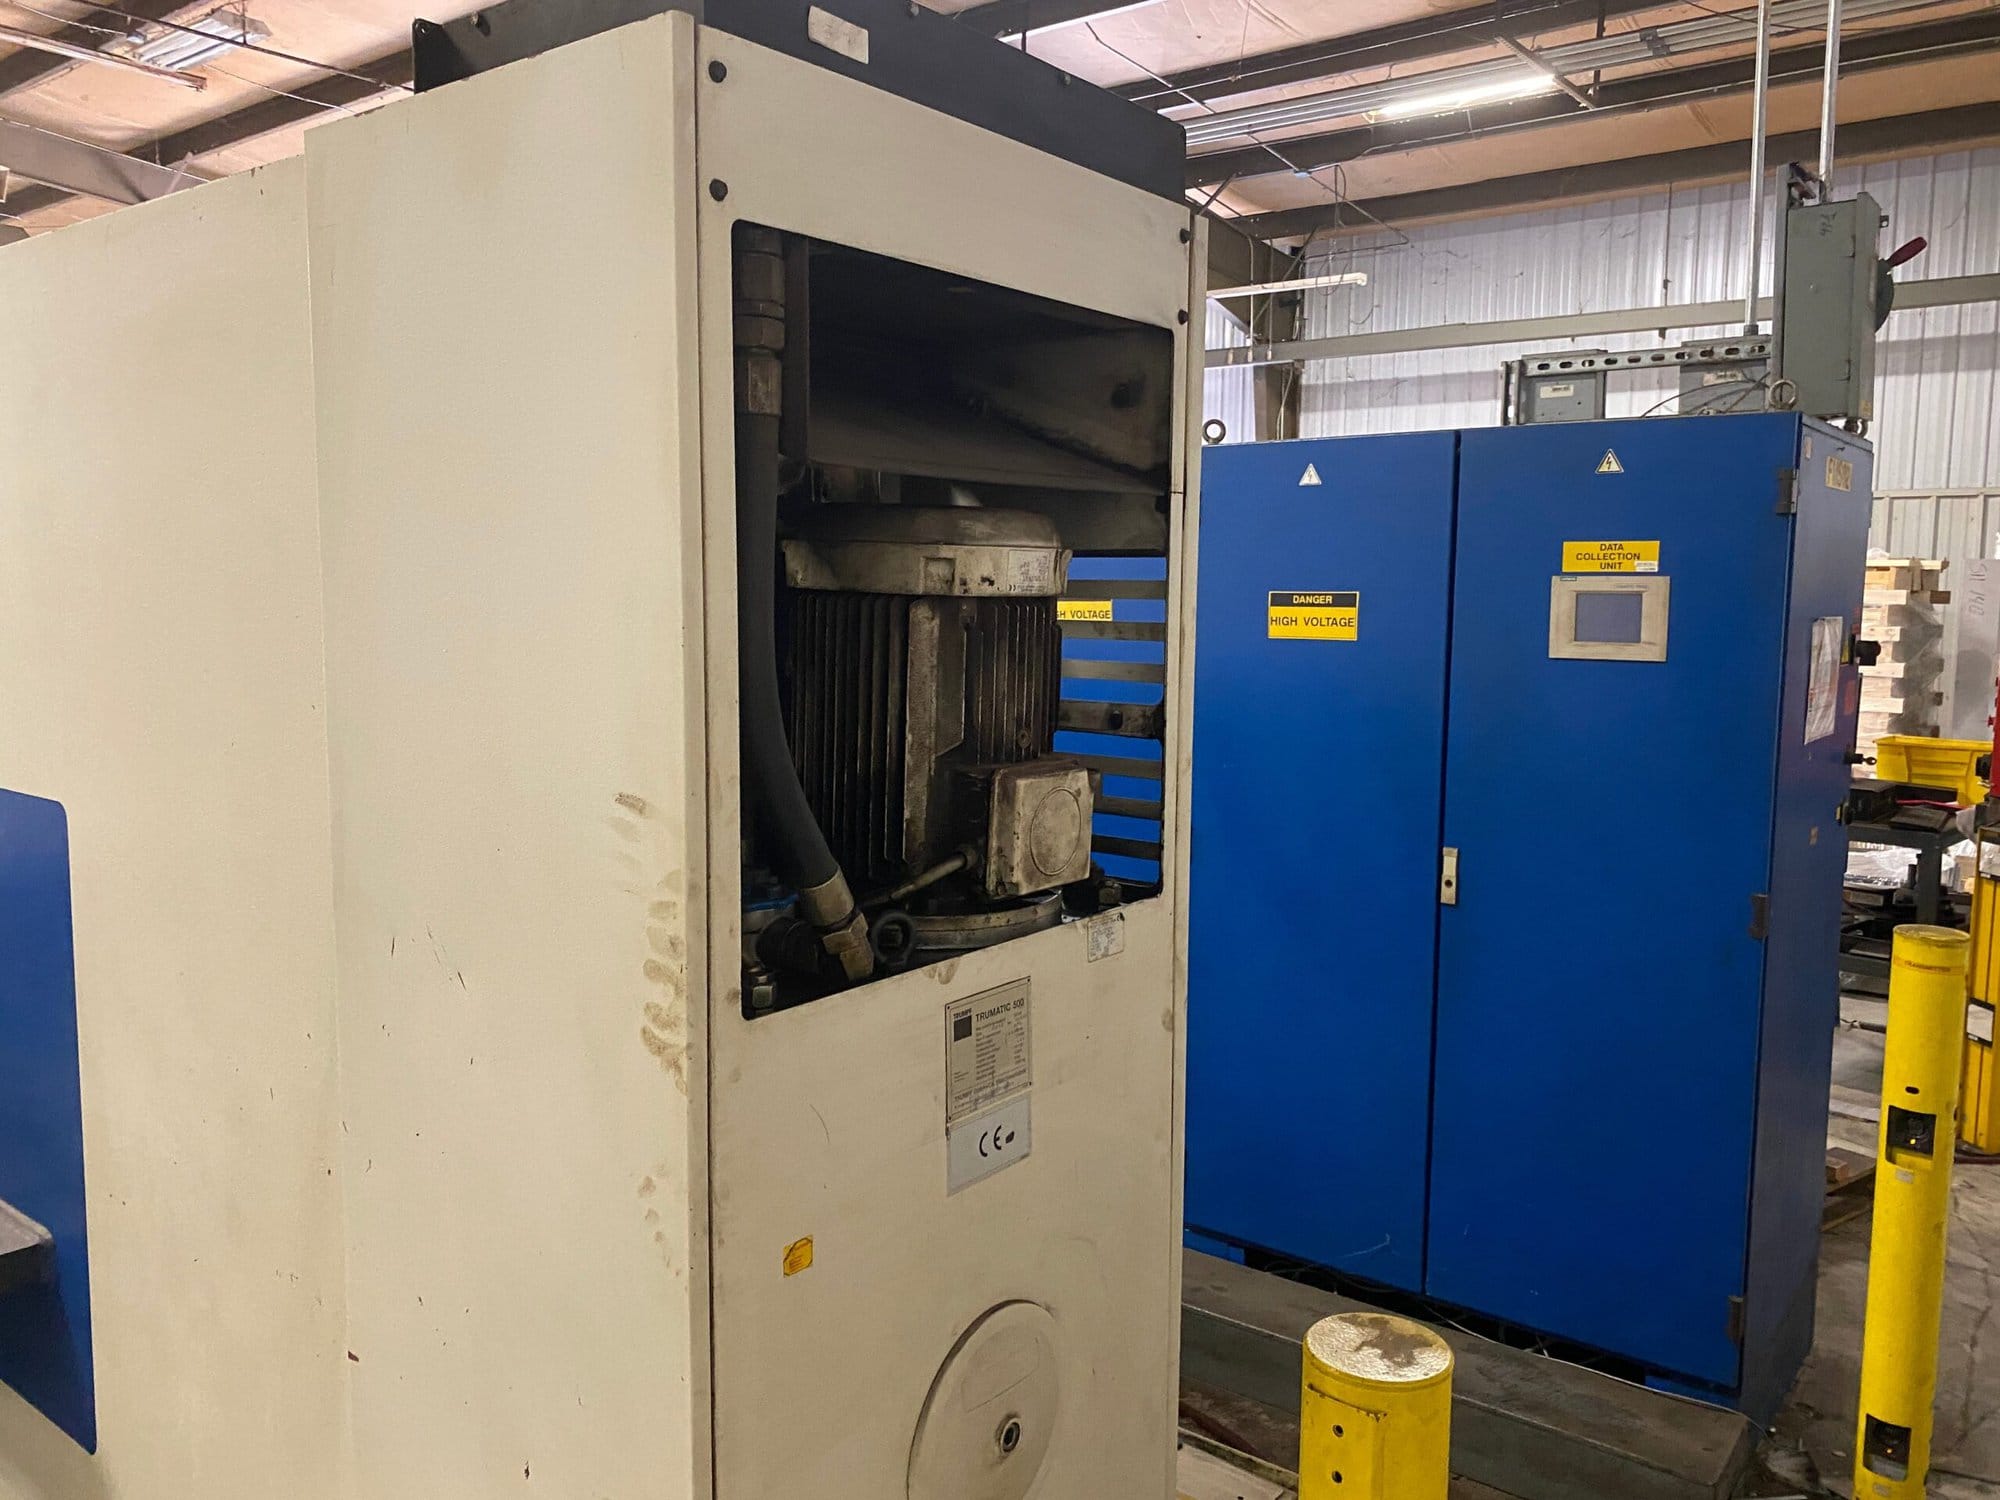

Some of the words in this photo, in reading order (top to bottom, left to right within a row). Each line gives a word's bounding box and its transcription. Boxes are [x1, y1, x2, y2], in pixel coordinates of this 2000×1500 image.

[1600, 543, 1624, 552] DATA
[1576, 552, 1641, 561] COLLECTION
[1600, 562, 1623, 570] UNIT
[1292, 595, 1333, 604] DANGER
[1070, 610, 1111, 619] VOLTAGE
[1270, 616, 1298, 626] HIGH
[1303, 617, 1355, 627] VOLTAGE
[975, 1003, 1011, 1022] TRUMATIC
